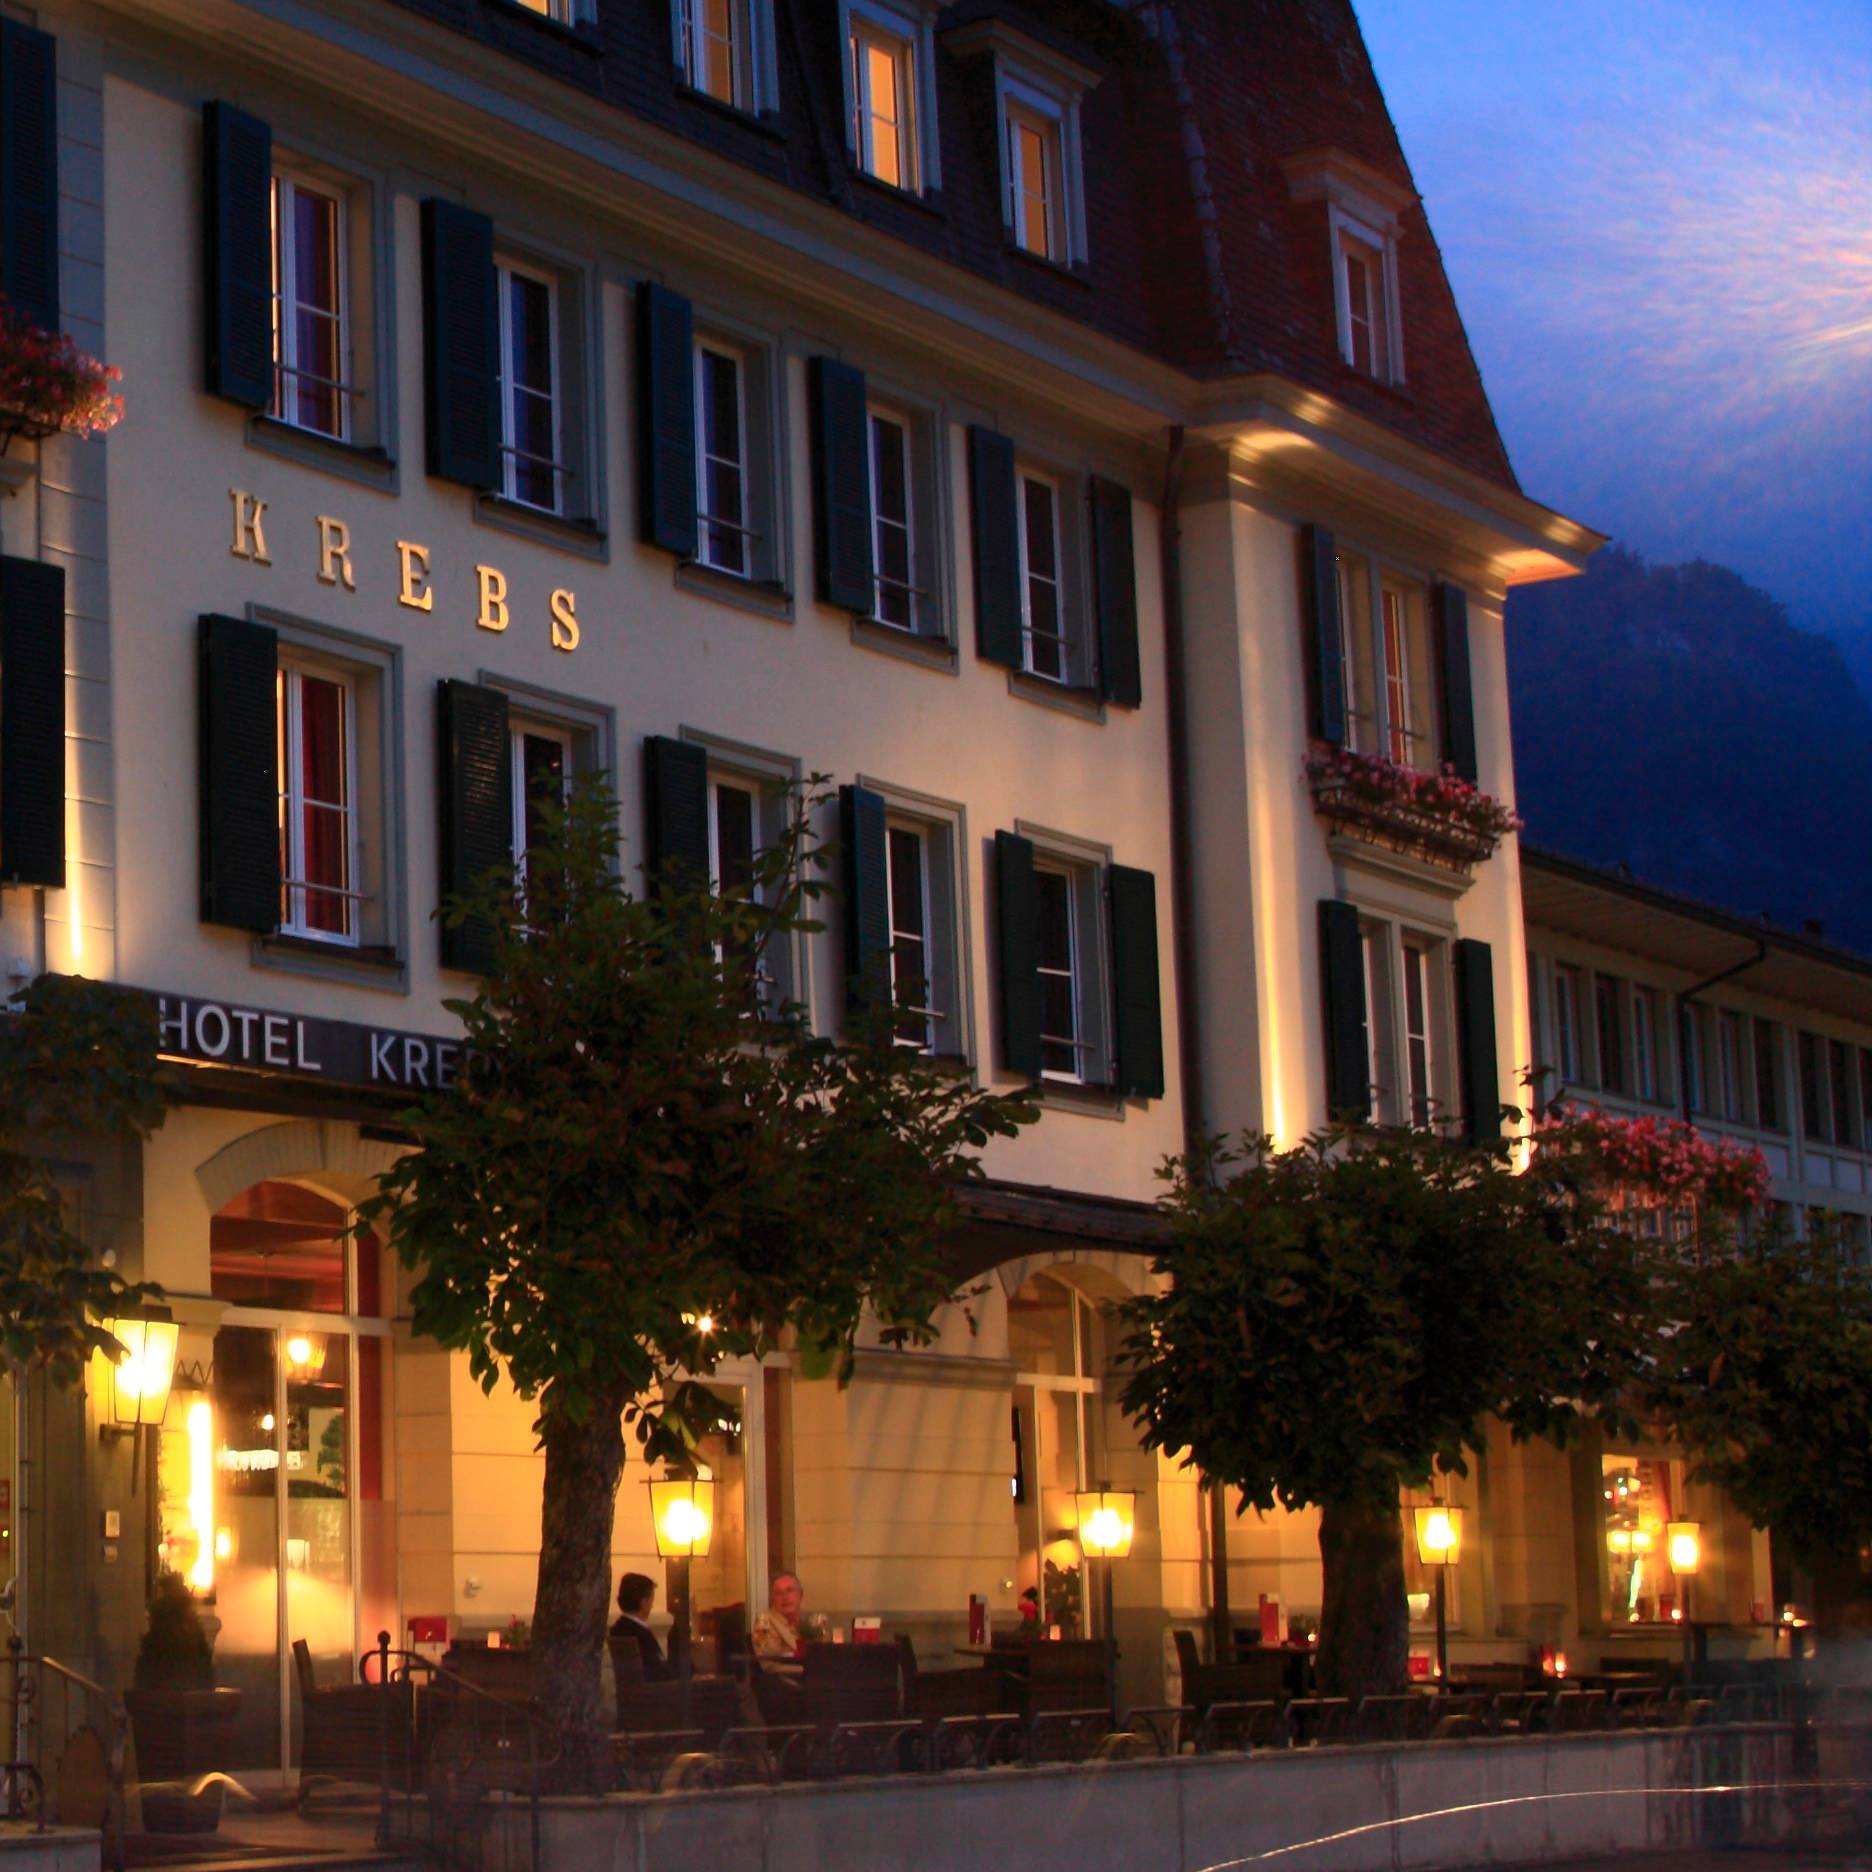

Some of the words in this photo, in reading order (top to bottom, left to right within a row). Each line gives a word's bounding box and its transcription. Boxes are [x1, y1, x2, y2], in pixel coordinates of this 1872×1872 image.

[229, 487, 581, 653] KREBS
[158, 997, 322, 1071] HOTEL
[370, 1031, 504, 1093] KRE
